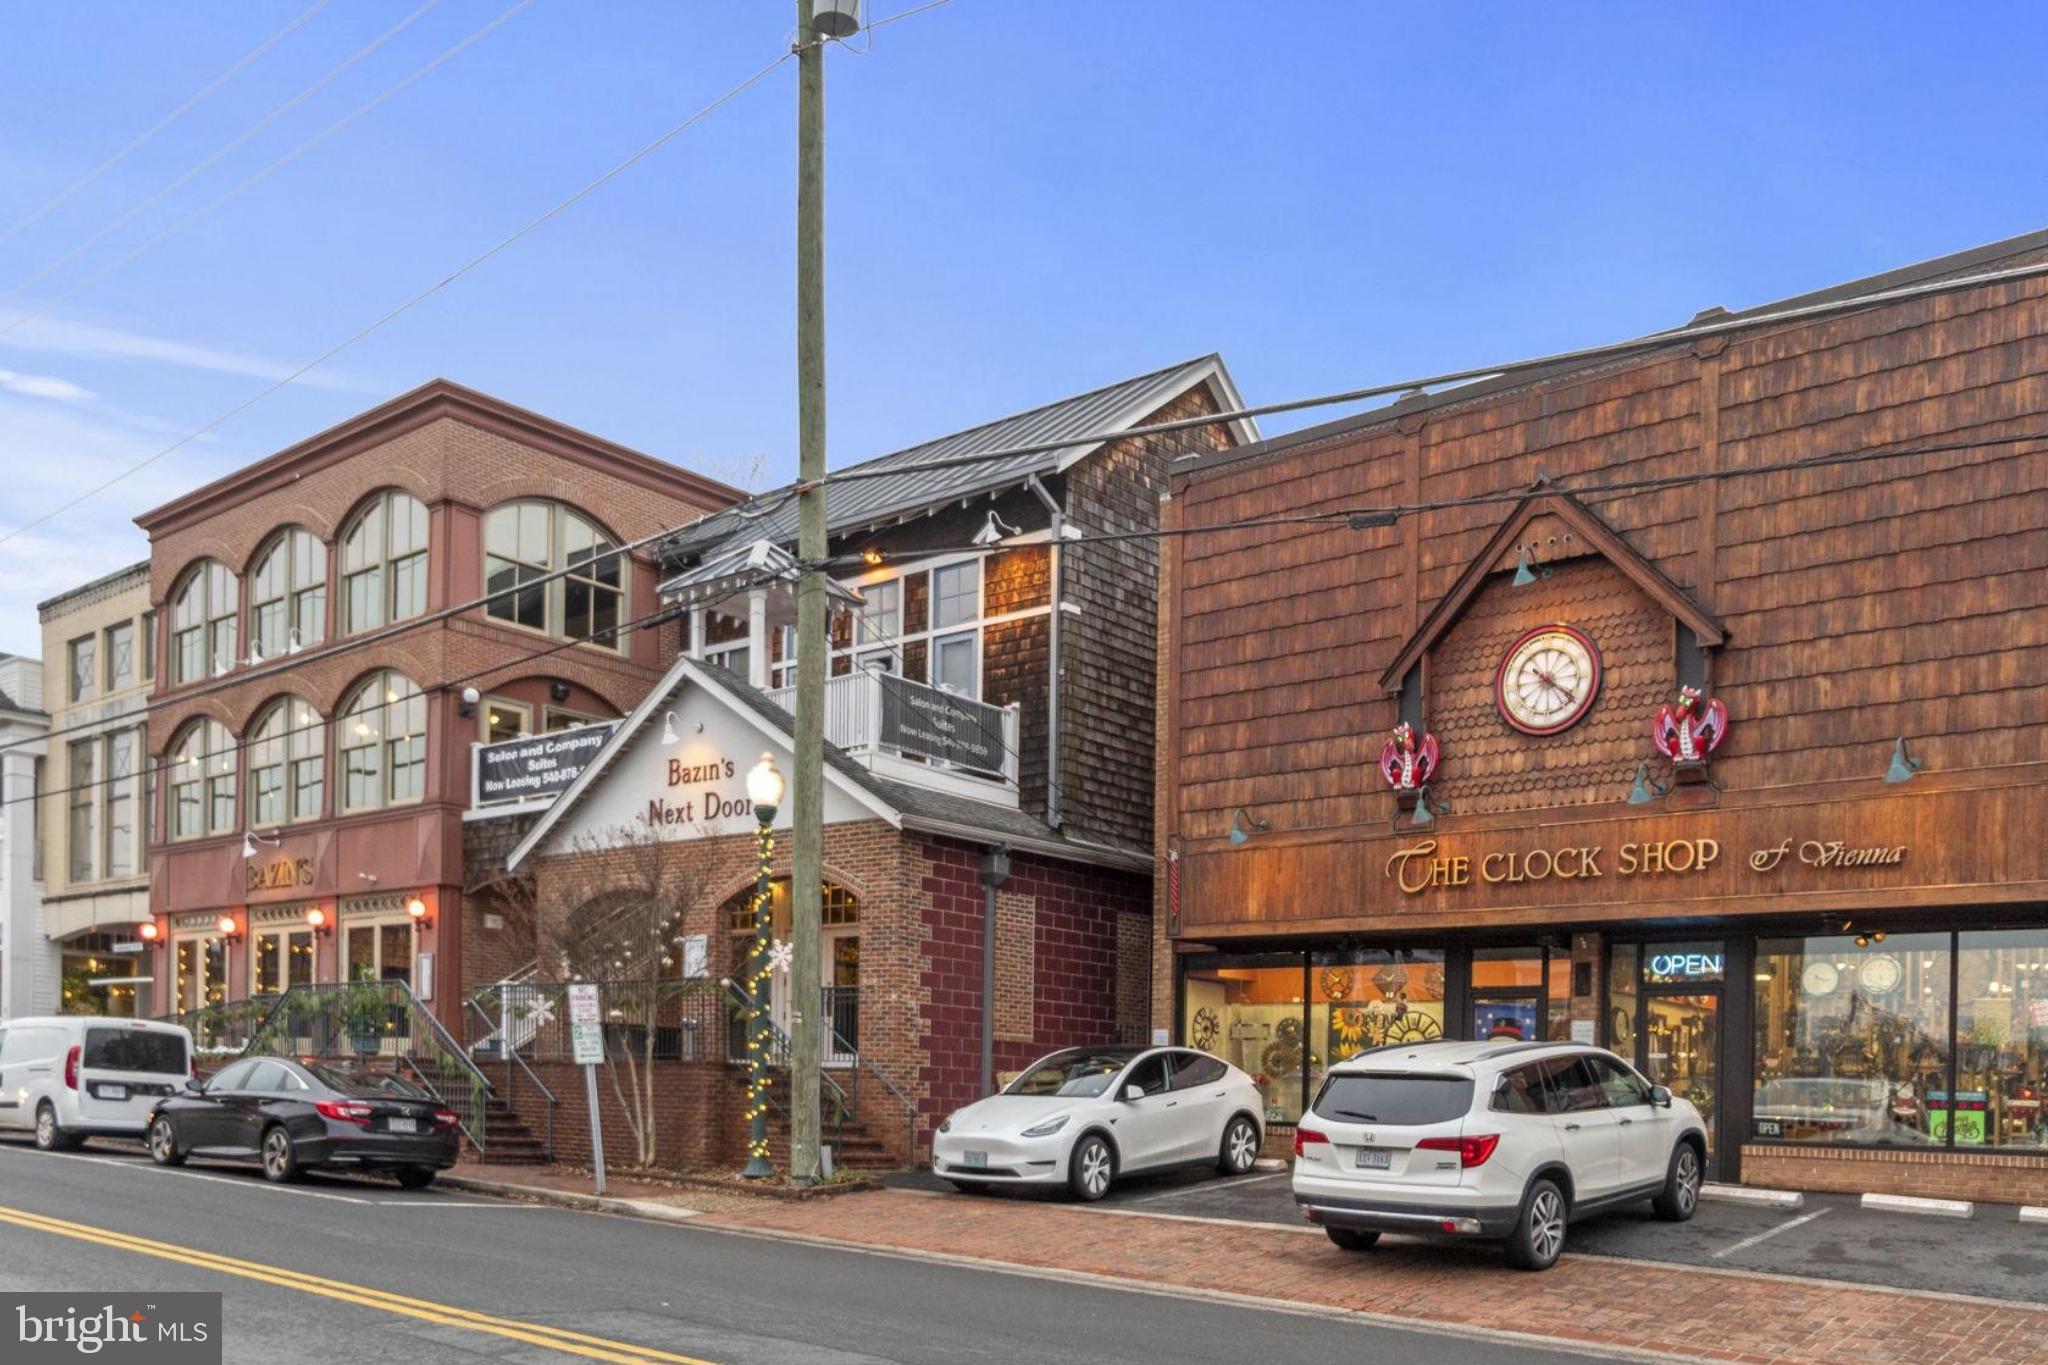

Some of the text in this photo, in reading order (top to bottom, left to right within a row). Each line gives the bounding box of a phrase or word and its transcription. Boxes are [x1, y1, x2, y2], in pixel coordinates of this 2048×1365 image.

[910, 696, 930, 709] Salon
[901, 724, 917, 736] Now
[488, 736, 602, 763] Salon and Company
[528, 758, 557, 771] Suites
[668, 758, 734, 787] Bazin's
[486, 781, 503, 792] Now
[506, 776, 541, 788] Leasing
[648, 798, 693, 827] Next
[1386, 838, 1907, 893] THE CLOCK SHOP of Vienna
[1652, 954, 1720, 975] OPEN
[1759, 1122, 1780, 1135] OPEN
